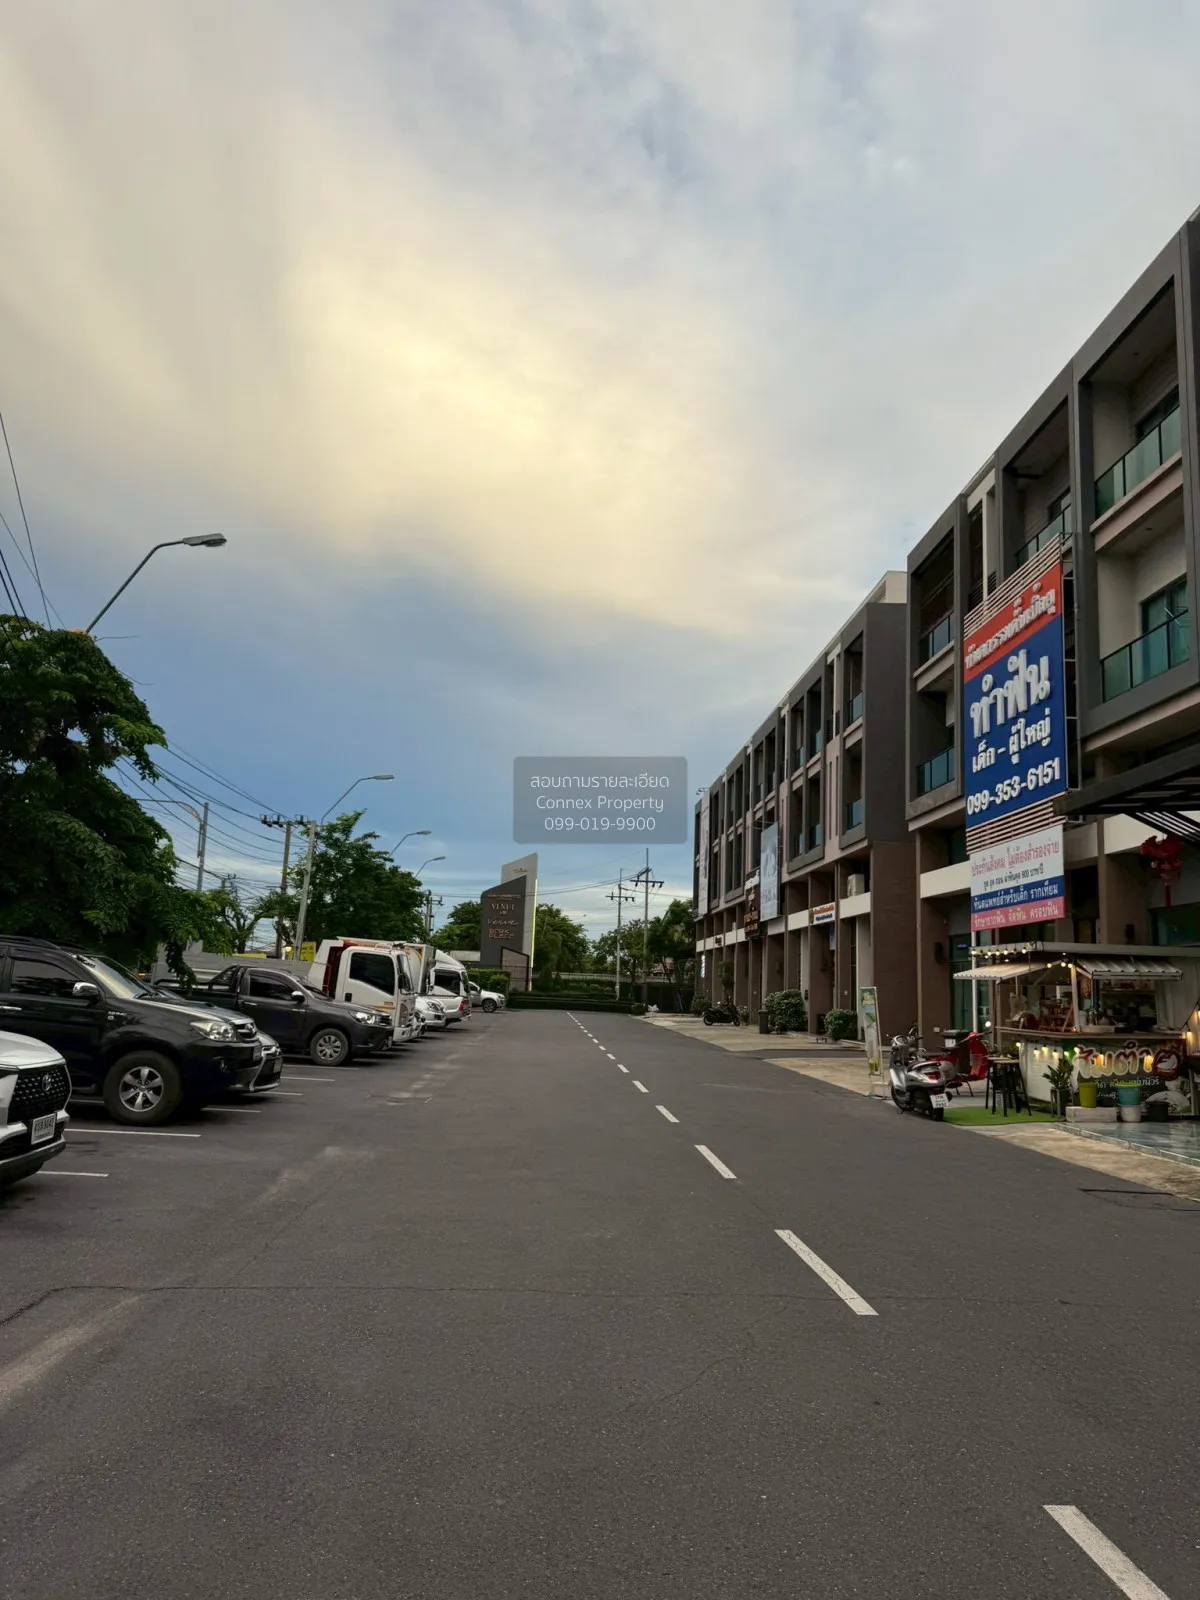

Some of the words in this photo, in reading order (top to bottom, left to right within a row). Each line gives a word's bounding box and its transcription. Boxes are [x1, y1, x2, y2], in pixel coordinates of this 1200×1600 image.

[970, 648, 1051, 739] ทำฟัน
[972, 739, 996, 773] เด็ก
[1009, 707, 1051, 765] ผู้ใหญ่
[967, 757, 1061, 815] 099-353-6151
[1030, 880, 1059, 899] รากเทียม
